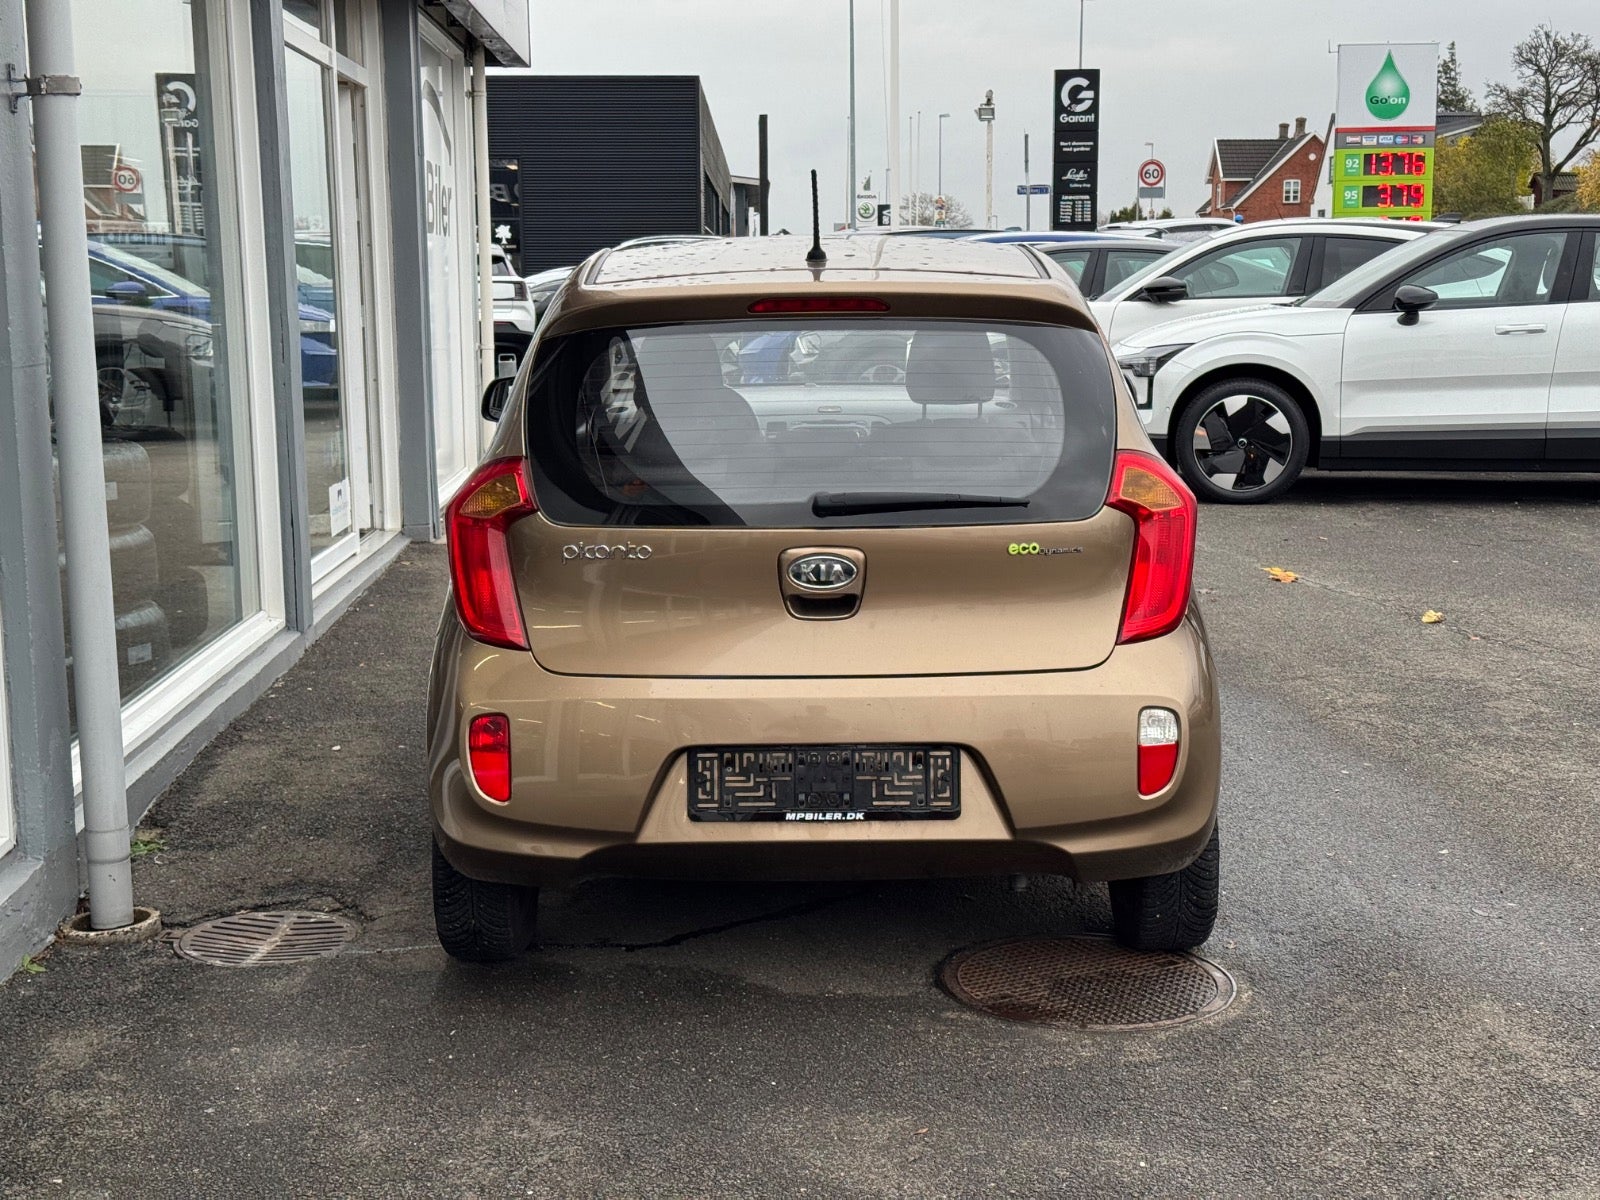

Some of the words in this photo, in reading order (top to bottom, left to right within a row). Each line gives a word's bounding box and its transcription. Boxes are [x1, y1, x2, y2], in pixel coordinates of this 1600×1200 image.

[1370, 95, 1406, 105] Go'on
[1060, 113, 1095, 123] Garant
[1345, 158, 1360, 168] 92
[1144, 168, 1160, 180] 60
[426, 160, 452, 237] Biler
[1344, 190, 1358, 200] 95
[562, 541, 652, 565] picanto
[801, 564, 846, 581] KIA
[785, 812, 865, 821] MPBILER.DK
